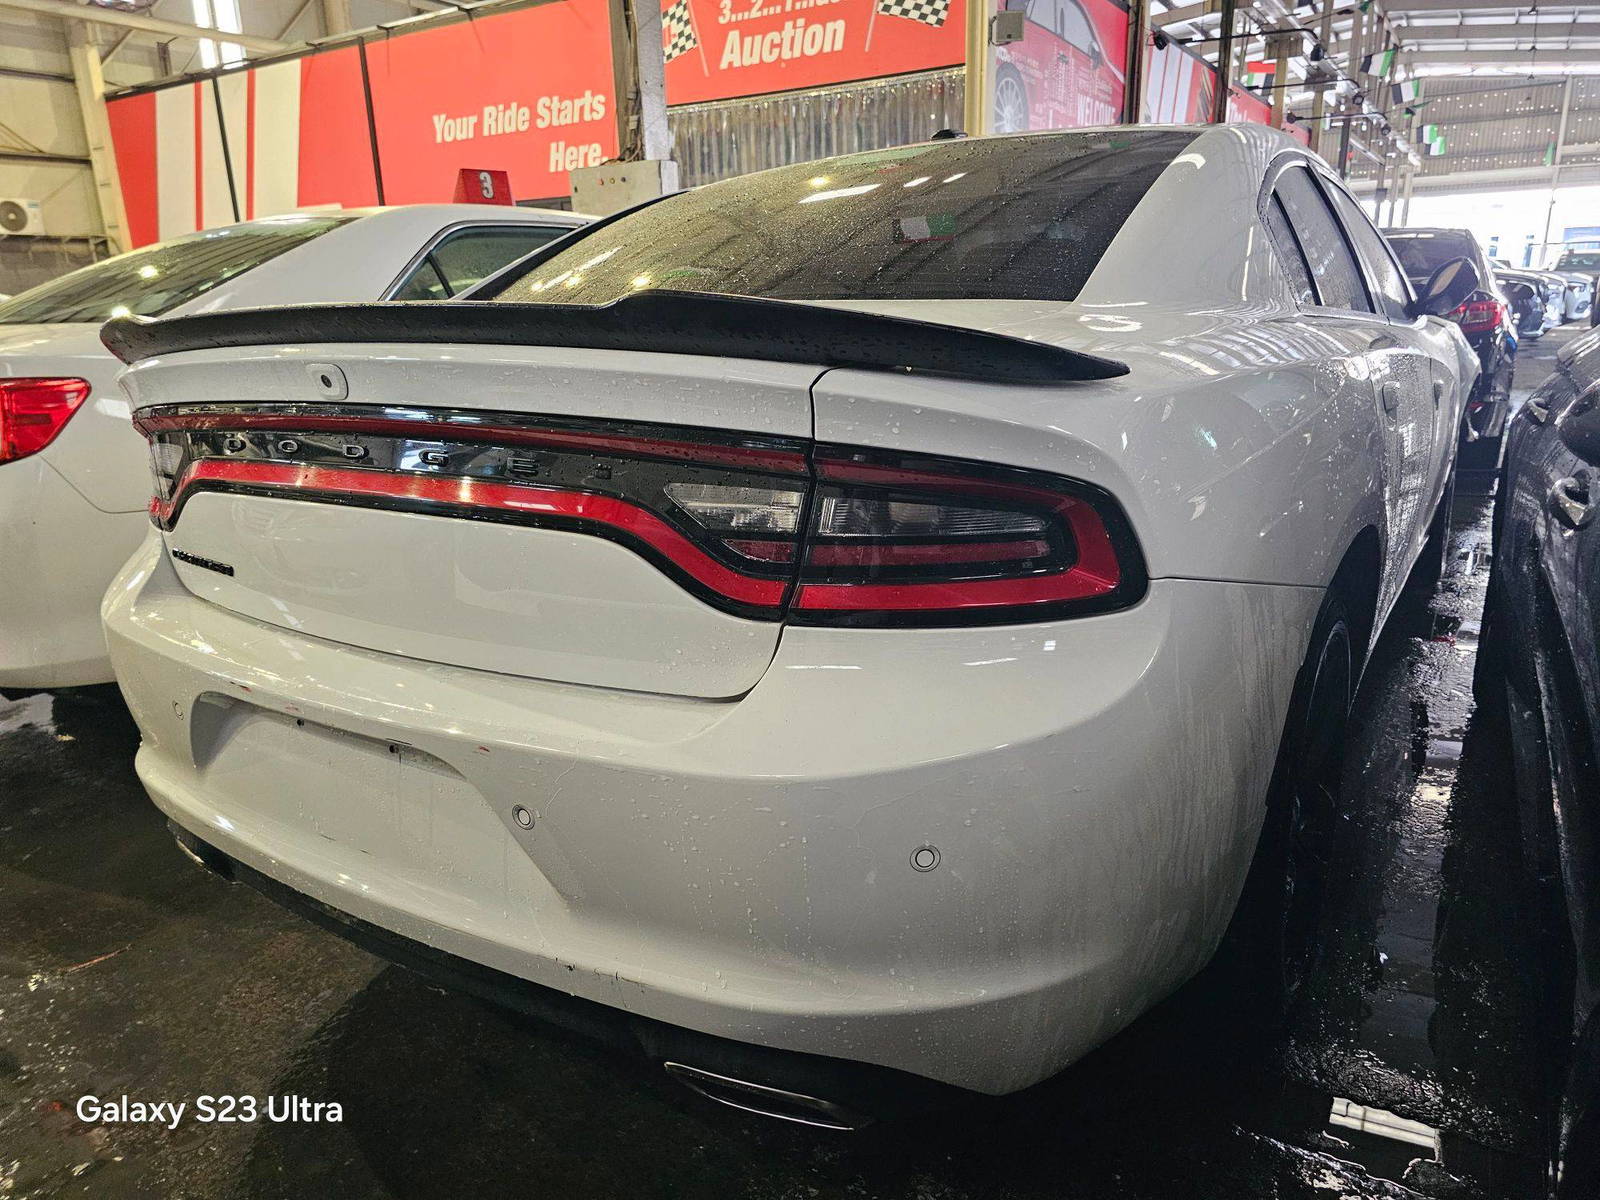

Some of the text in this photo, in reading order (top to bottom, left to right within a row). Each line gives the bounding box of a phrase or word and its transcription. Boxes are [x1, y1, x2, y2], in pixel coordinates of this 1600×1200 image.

[719, 18, 846, 70] Auction
[432, 89, 606, 144] Your Ride Starts
[549, 140, 609, 173] Here.
[479, 171, 495, 199] 3
[223, 436, 539, 478] DODGE
